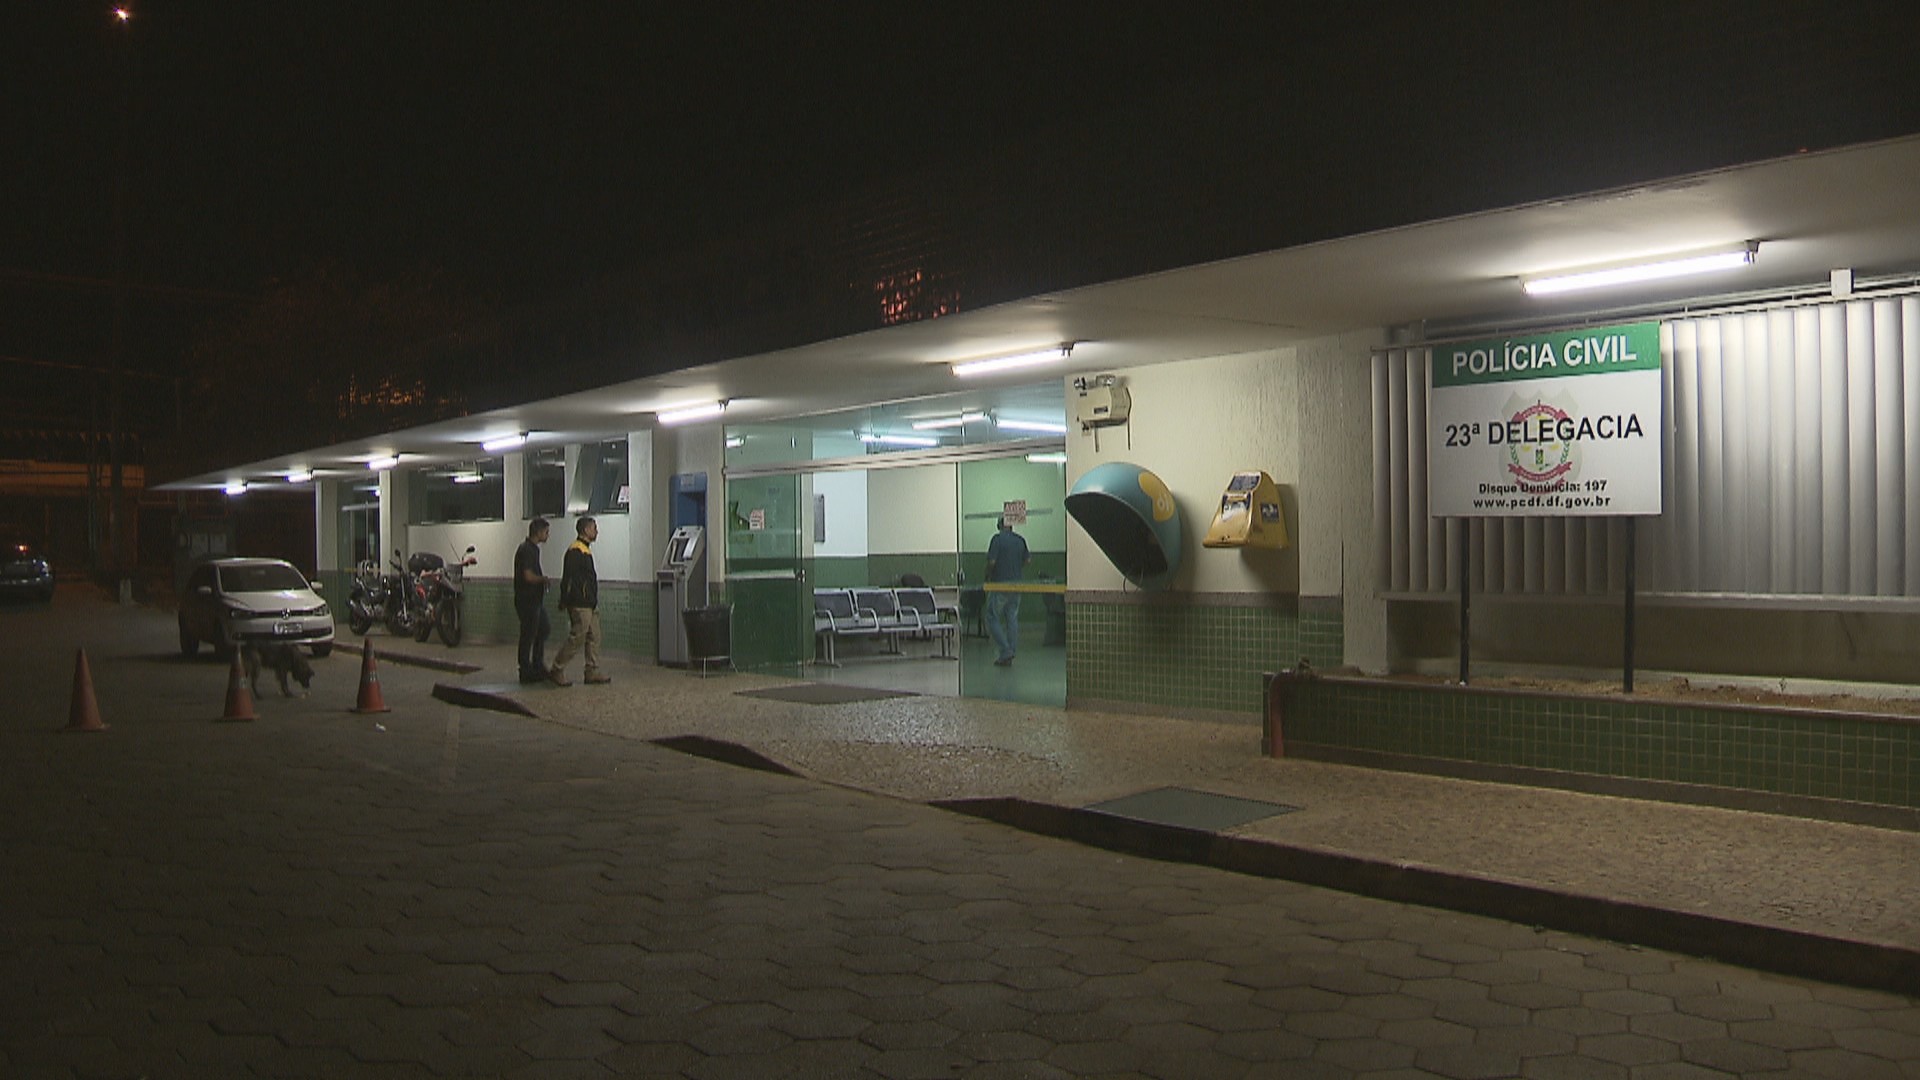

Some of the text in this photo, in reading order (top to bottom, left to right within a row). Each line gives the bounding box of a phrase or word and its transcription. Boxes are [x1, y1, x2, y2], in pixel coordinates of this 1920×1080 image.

[1452, 335, 1637, 377] POLÍCIA CIVIL
[1445, 413, 1643, 447] 23ª DELEGACIA
[1479, 483, 1517, 496] Disque
[1585, 480, 1608, 492] 197
[1473, 495, 1611, 510] www.pcdf.df.gov.br
